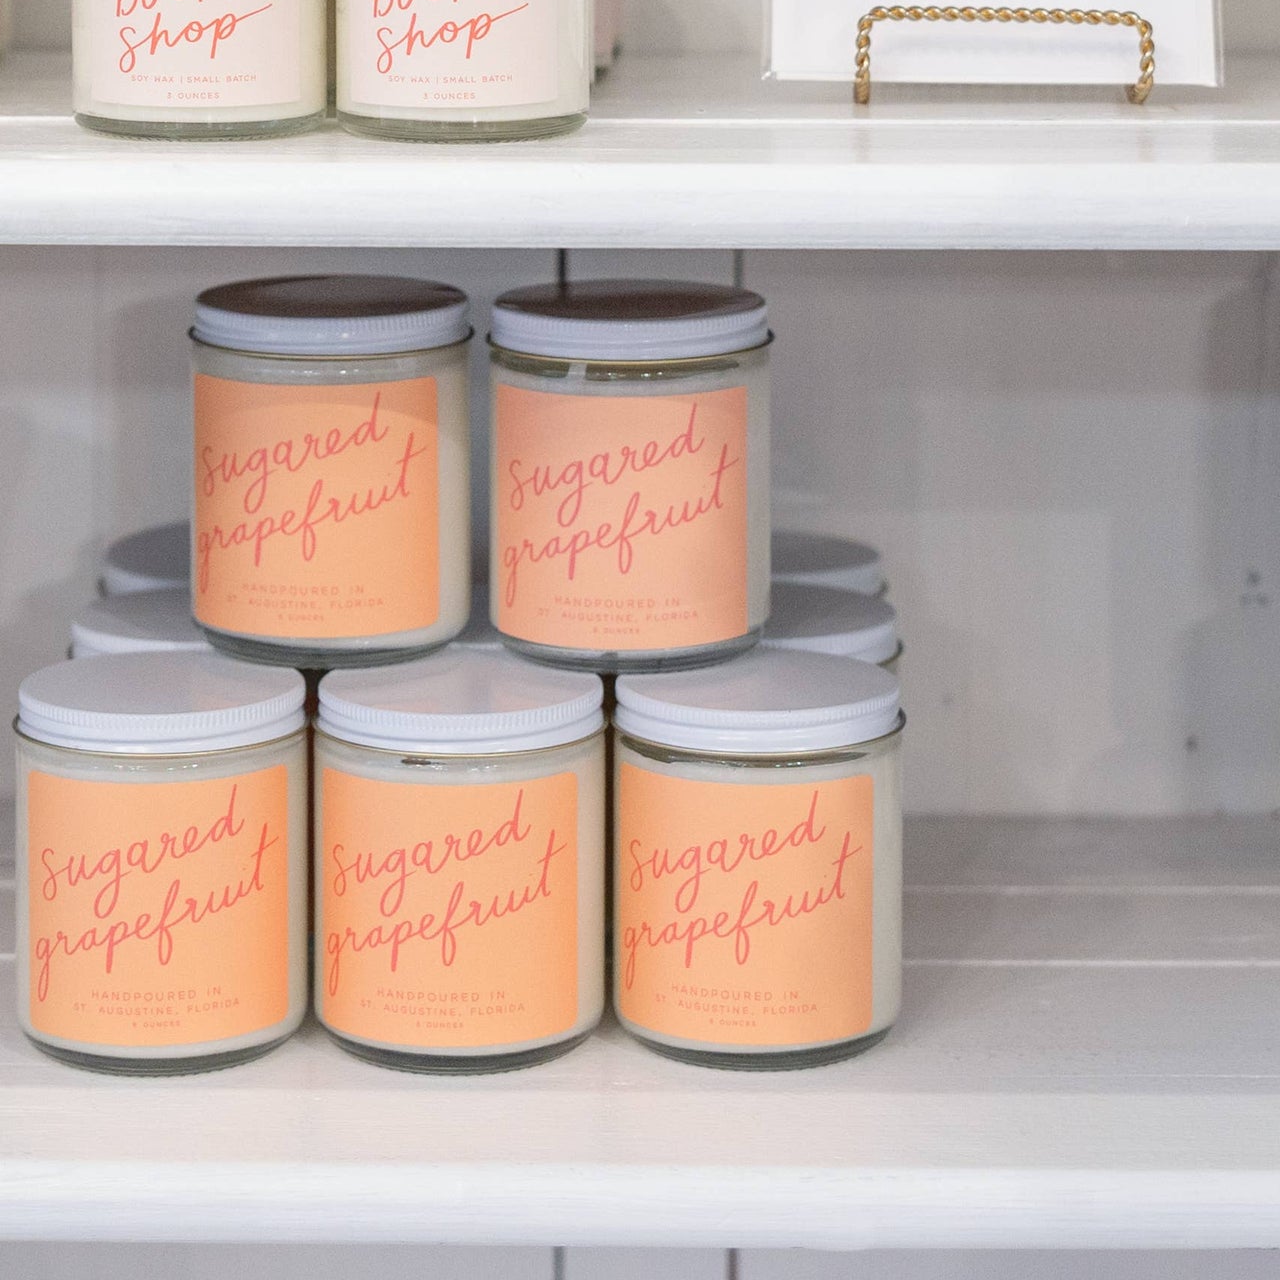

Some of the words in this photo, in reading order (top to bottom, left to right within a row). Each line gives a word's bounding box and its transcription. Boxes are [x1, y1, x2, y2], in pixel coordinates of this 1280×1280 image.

[118, 4, 272, 74] shop
[376, 3, 528, 74] shop
[131, 74, 149, 82] SOY
[153, 75, 175, 83] WAX
[186, 76, 221, 84] SMALL
[225, 74, 257, 83] BATCH
[177, 91, 220, 100] OUNCES
[388, 74, 405, 83] SOY
[442, 76, 477, 84] SMALL
[481, 74, 513, 83] BATCH
[423, 92, 429, 100] 3
[433, 92, 476, 100] OUNCES
[203, 389, 389, 515] sugared
[509, 401, 705, 528] sugared
[198, 432, 425, 595] grapefruit
[503, 444, 739, 609] grapefruit
[553, 595, 656, 609] HANDPOURED
[665, 597, 680, 607] IN
[646, 610, 698, 622] FLORIDA
[41, 784, 245, 919] sugared
[327, 789, 531, 917] sugared
[628, 790, 826, 913] sugared
[35, 823, 280, 1003] grapefruit
[326, 829, 568, 998] grapefruit
[622, 832, 864, 993] grapefruit
[90, 989, 197, 1002] HANDPOURED
[206, 986, 222, 998] IN
[187, 997, 241, 1014] FLORIDA
[376, 987, 480, 1002] HANDPOURED
[490, 989, 506, 1001] IN
[470, 1002, 526, 1017] FLORIDA
[671, 983, 773, 1002] HANDPOURED
[784, 991, 799, 1001] IN
[762, 1003, 818, 1015] FLORIDA
